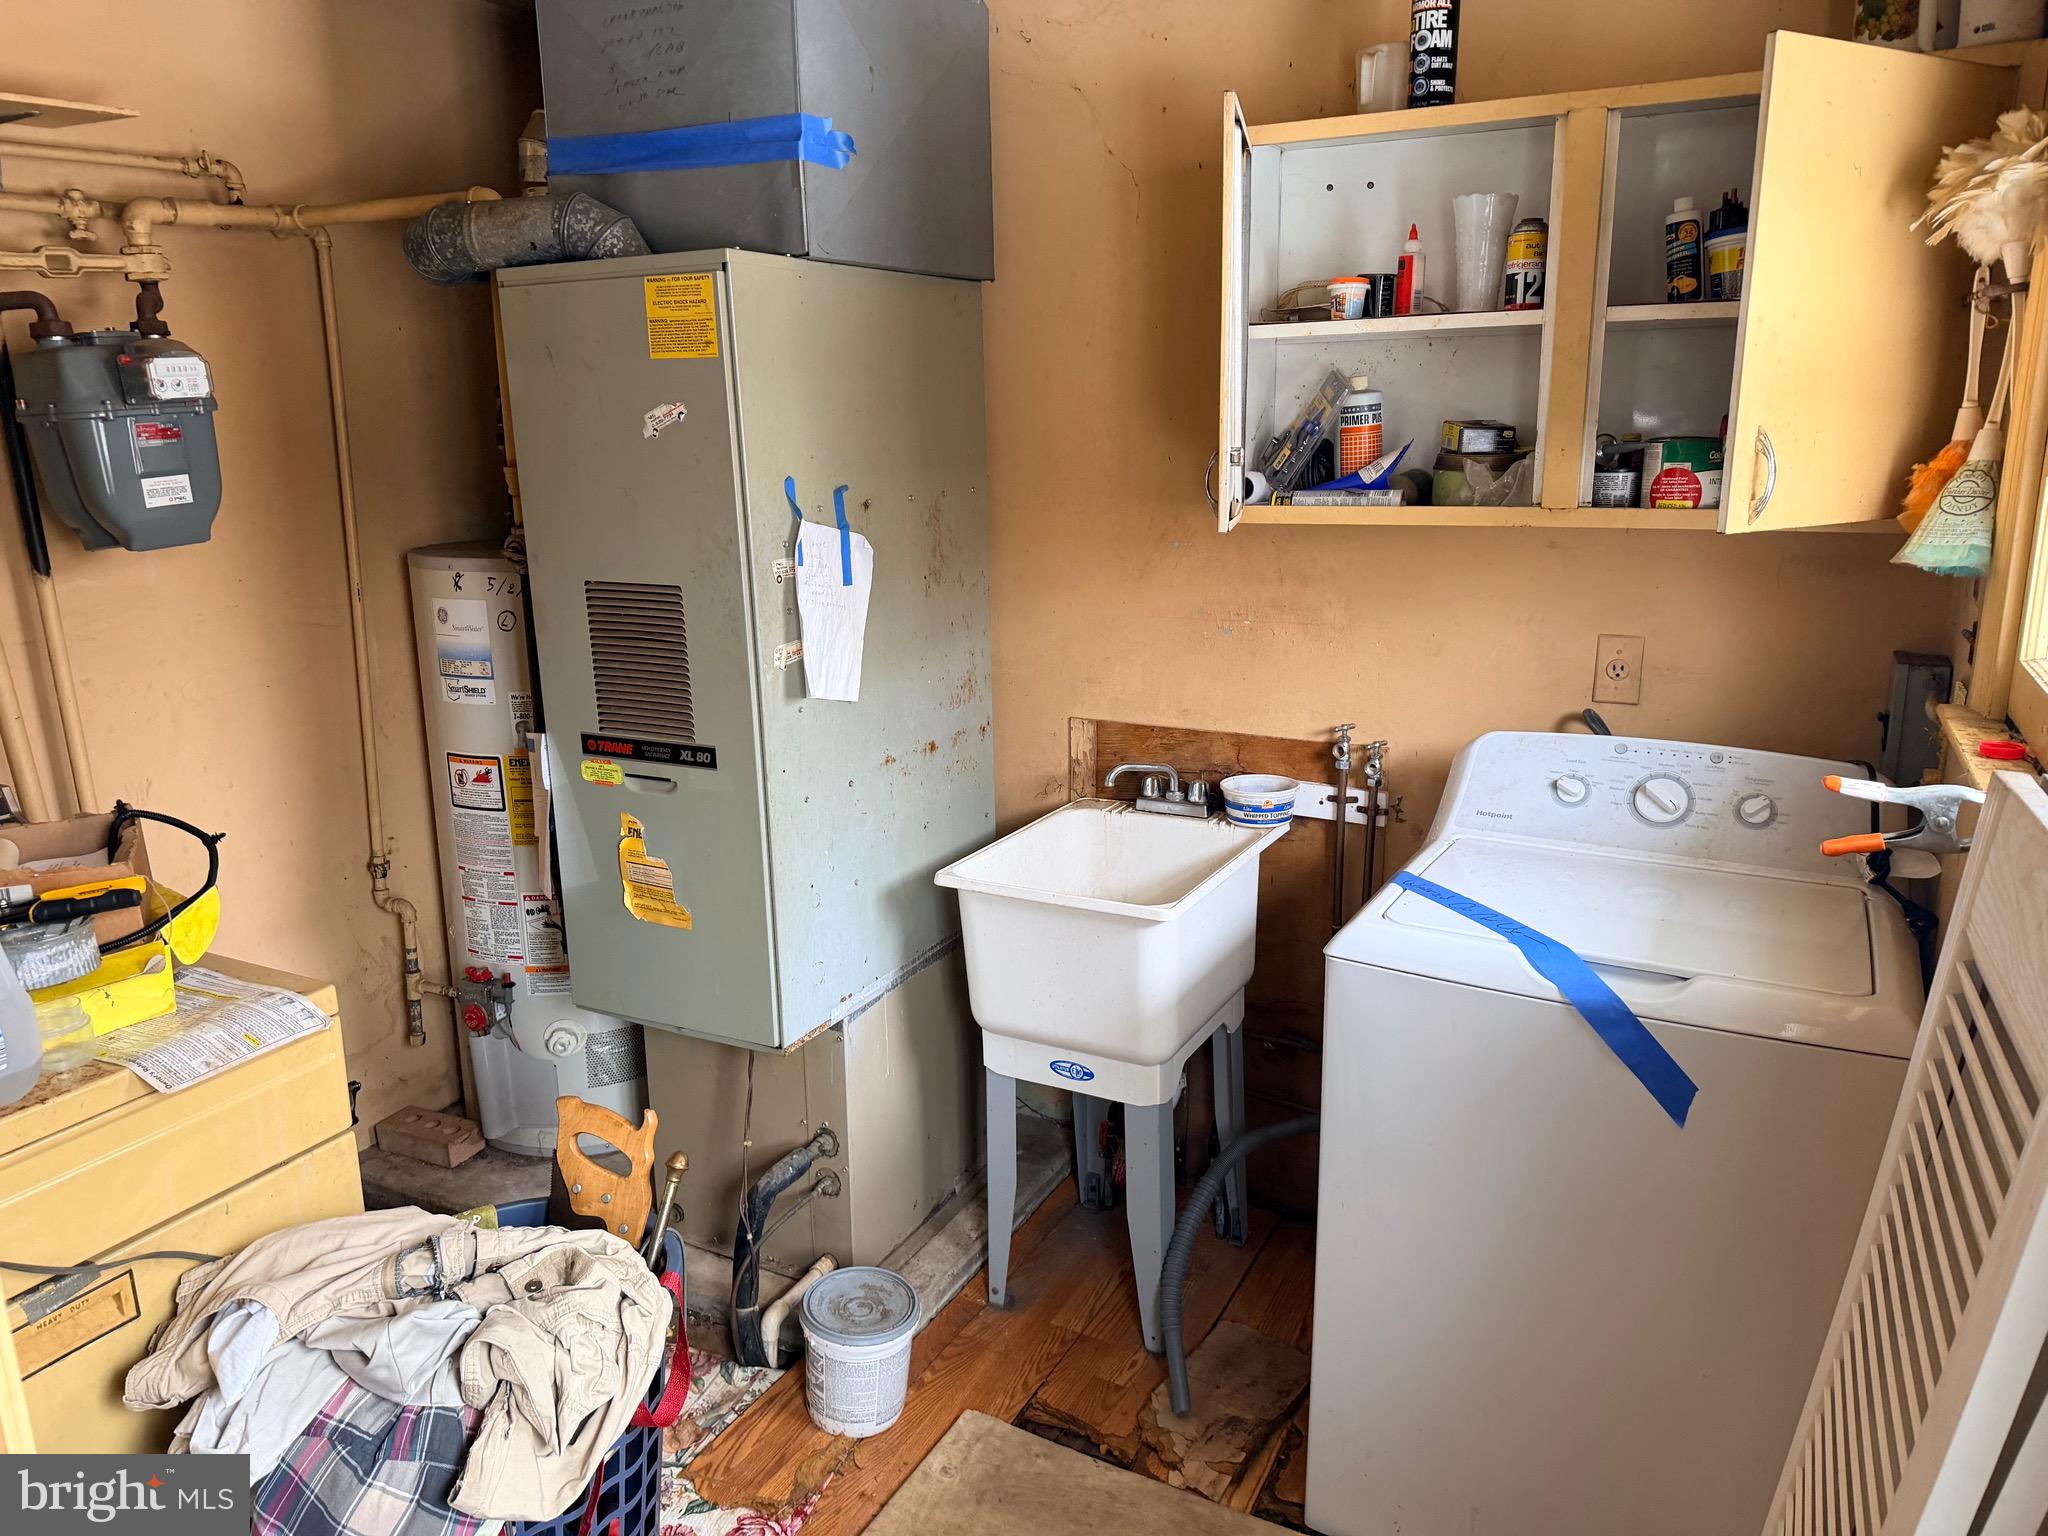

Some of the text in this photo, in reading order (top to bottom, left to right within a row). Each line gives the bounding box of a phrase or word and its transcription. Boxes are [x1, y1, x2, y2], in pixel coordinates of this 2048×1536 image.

[1414, 9, 1448, 31] TIRE
[1411, 29, 1453, 52] FOAM
[1515, 271, 1543, 304] 12
[1340, 414, 1370, 427] PRIMER
[597, 740, 711, 763] TRANE XL 80
[1476, 809, 1513, 820] Hotpoint
[36, 1298, 91, 1331] HEAVY DUTY
